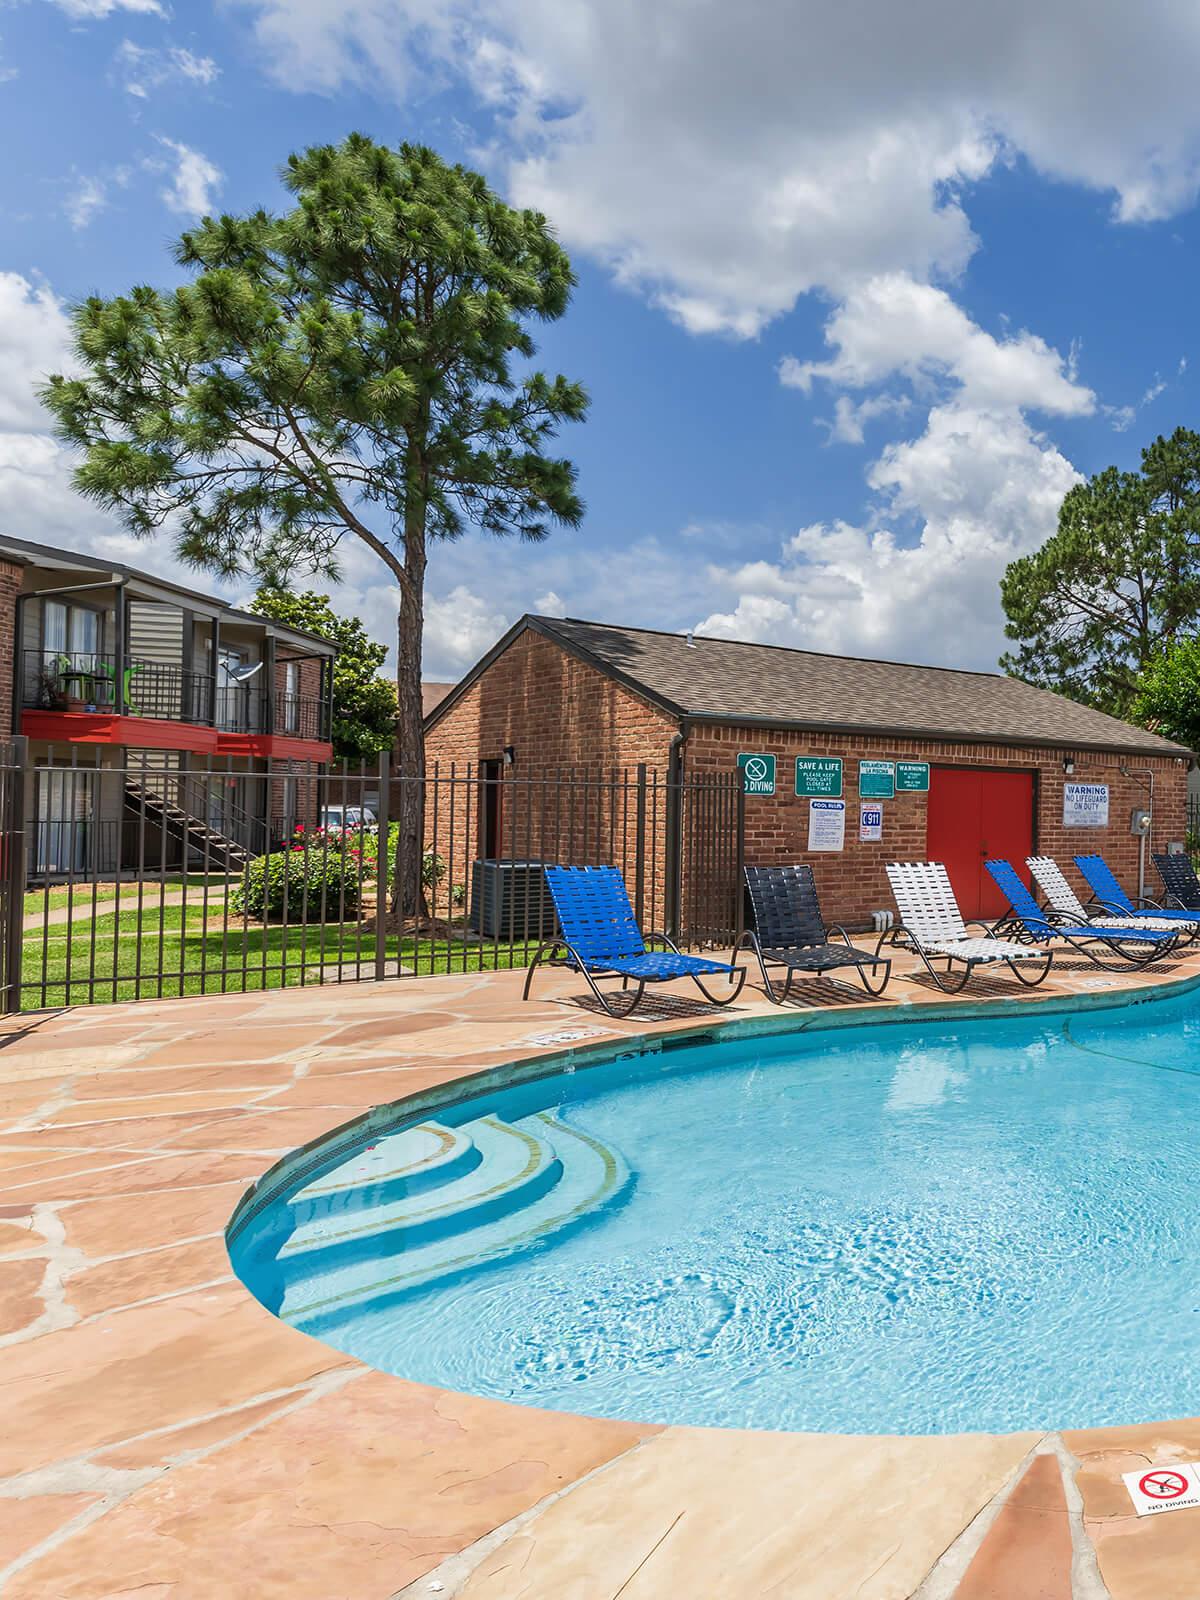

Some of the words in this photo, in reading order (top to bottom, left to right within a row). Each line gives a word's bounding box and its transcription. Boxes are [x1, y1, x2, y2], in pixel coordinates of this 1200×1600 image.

[750, 781, 773, 792] DIVING
[1068, 786, 1106, 794] WARNING
[868, 813, 879, 824] 911
[1166, 1498, 1199, 1508] DIVING
